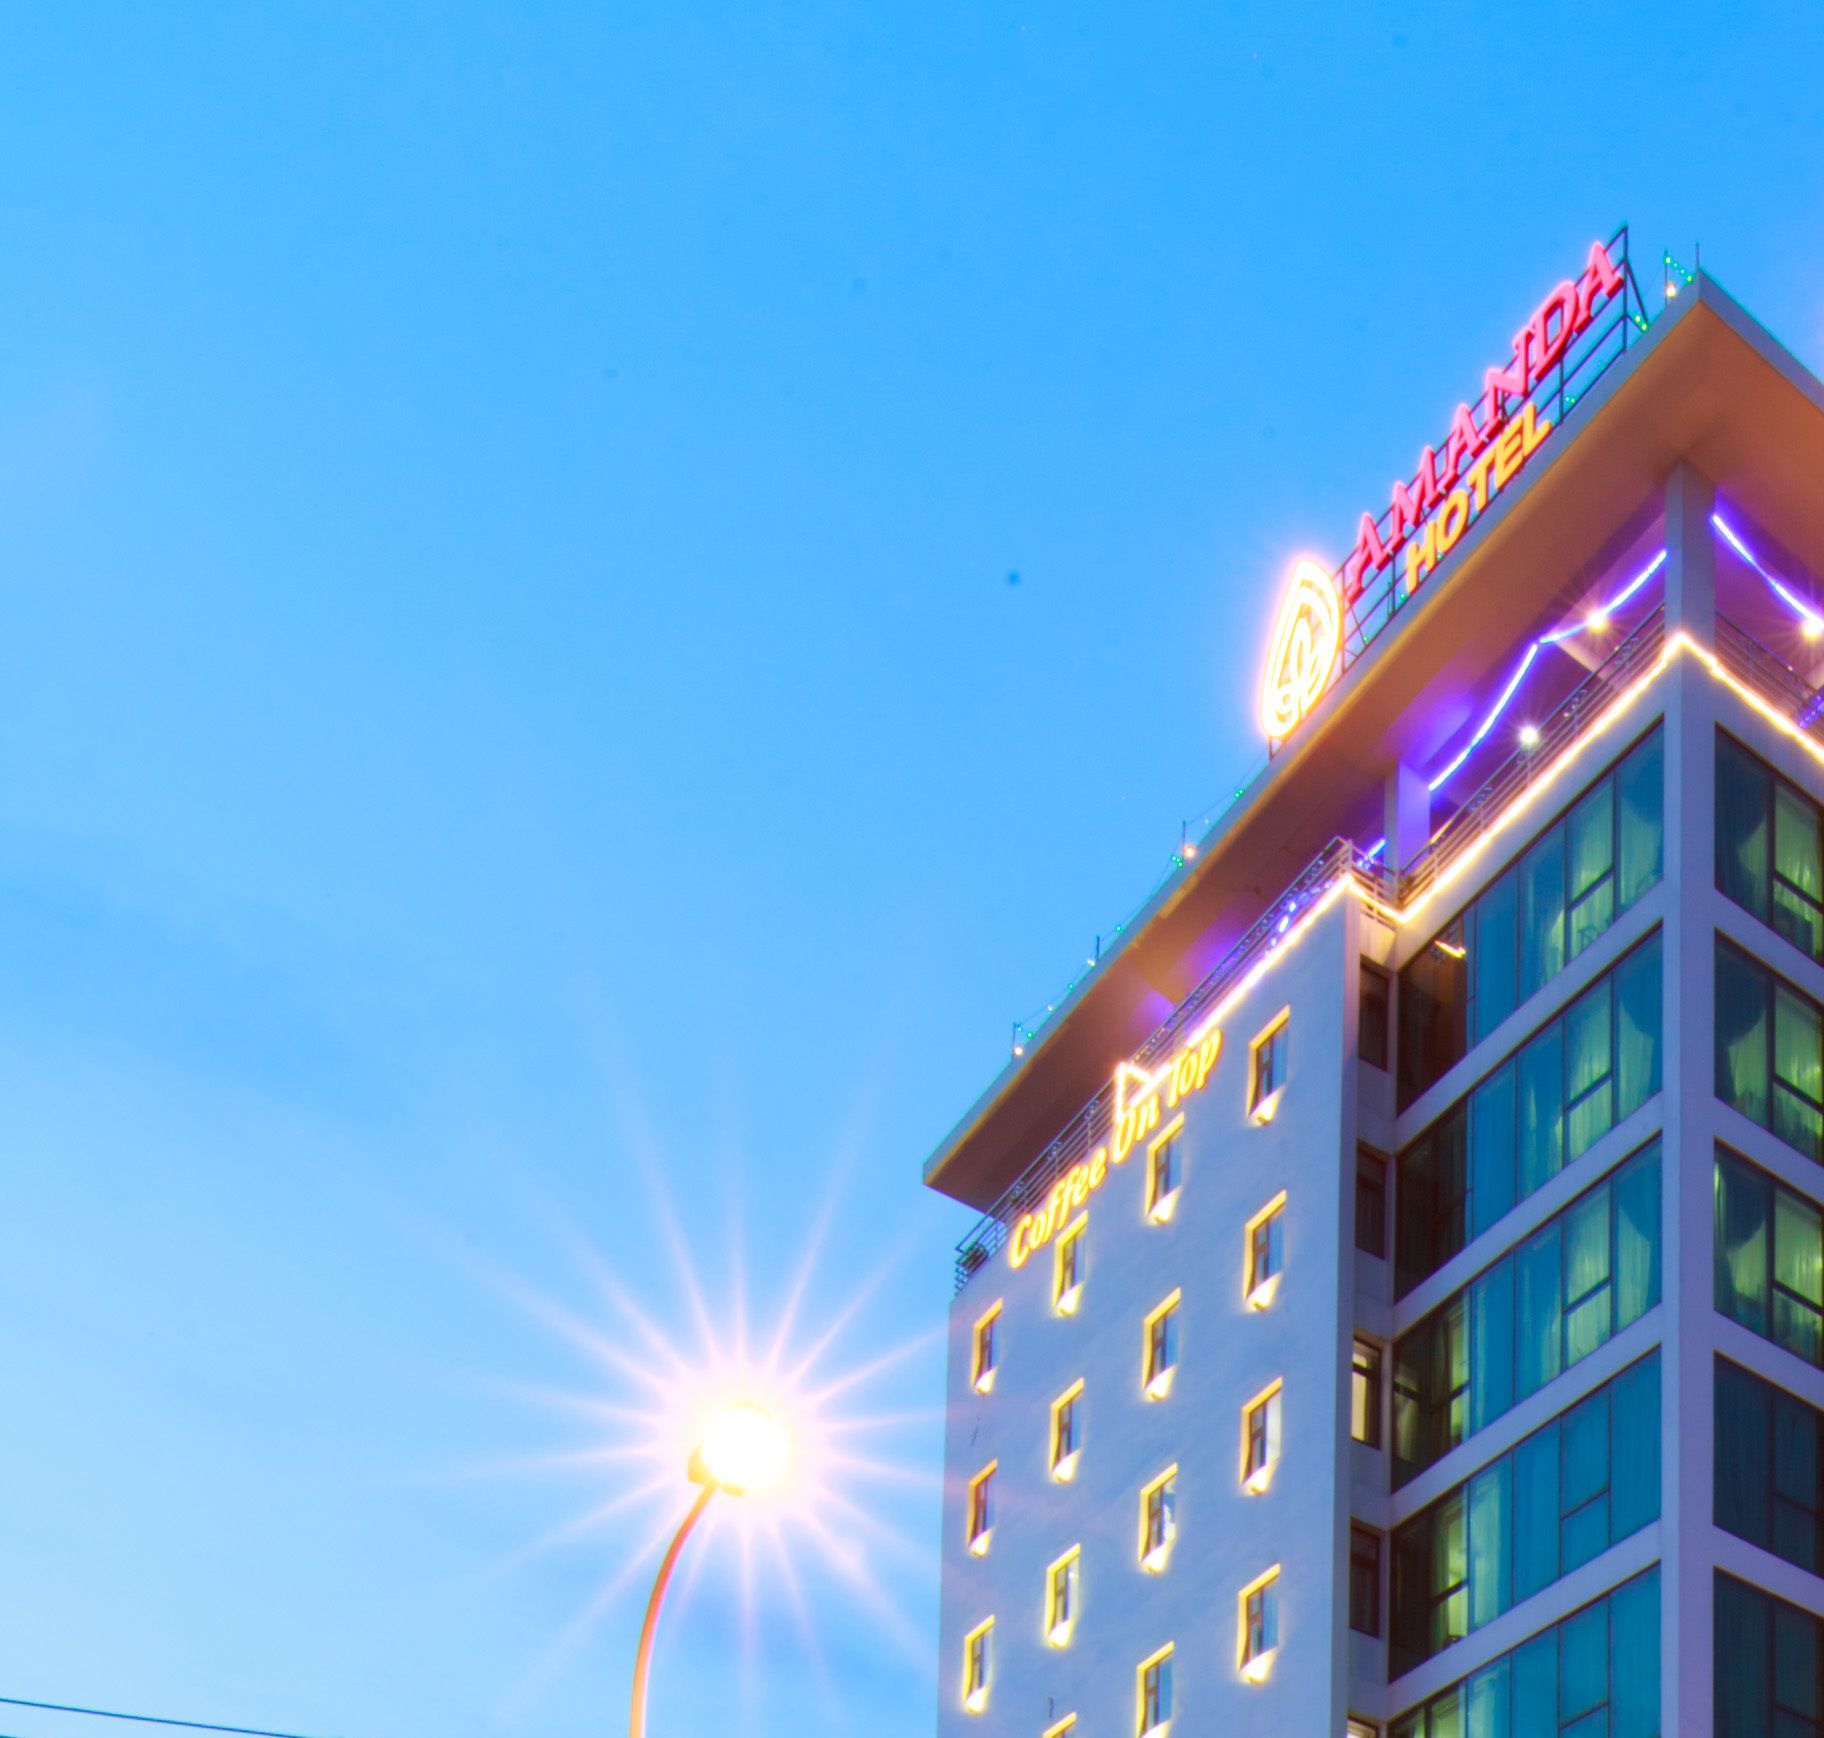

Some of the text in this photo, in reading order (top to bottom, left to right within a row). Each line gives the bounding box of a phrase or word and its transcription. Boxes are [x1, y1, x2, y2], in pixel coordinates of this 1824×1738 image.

[1345, 240, 1624, 600] AMANDA
[1405, 401, 1553, 593] HOTEL
[1008, 1147, 1107, 1269] Coffee
